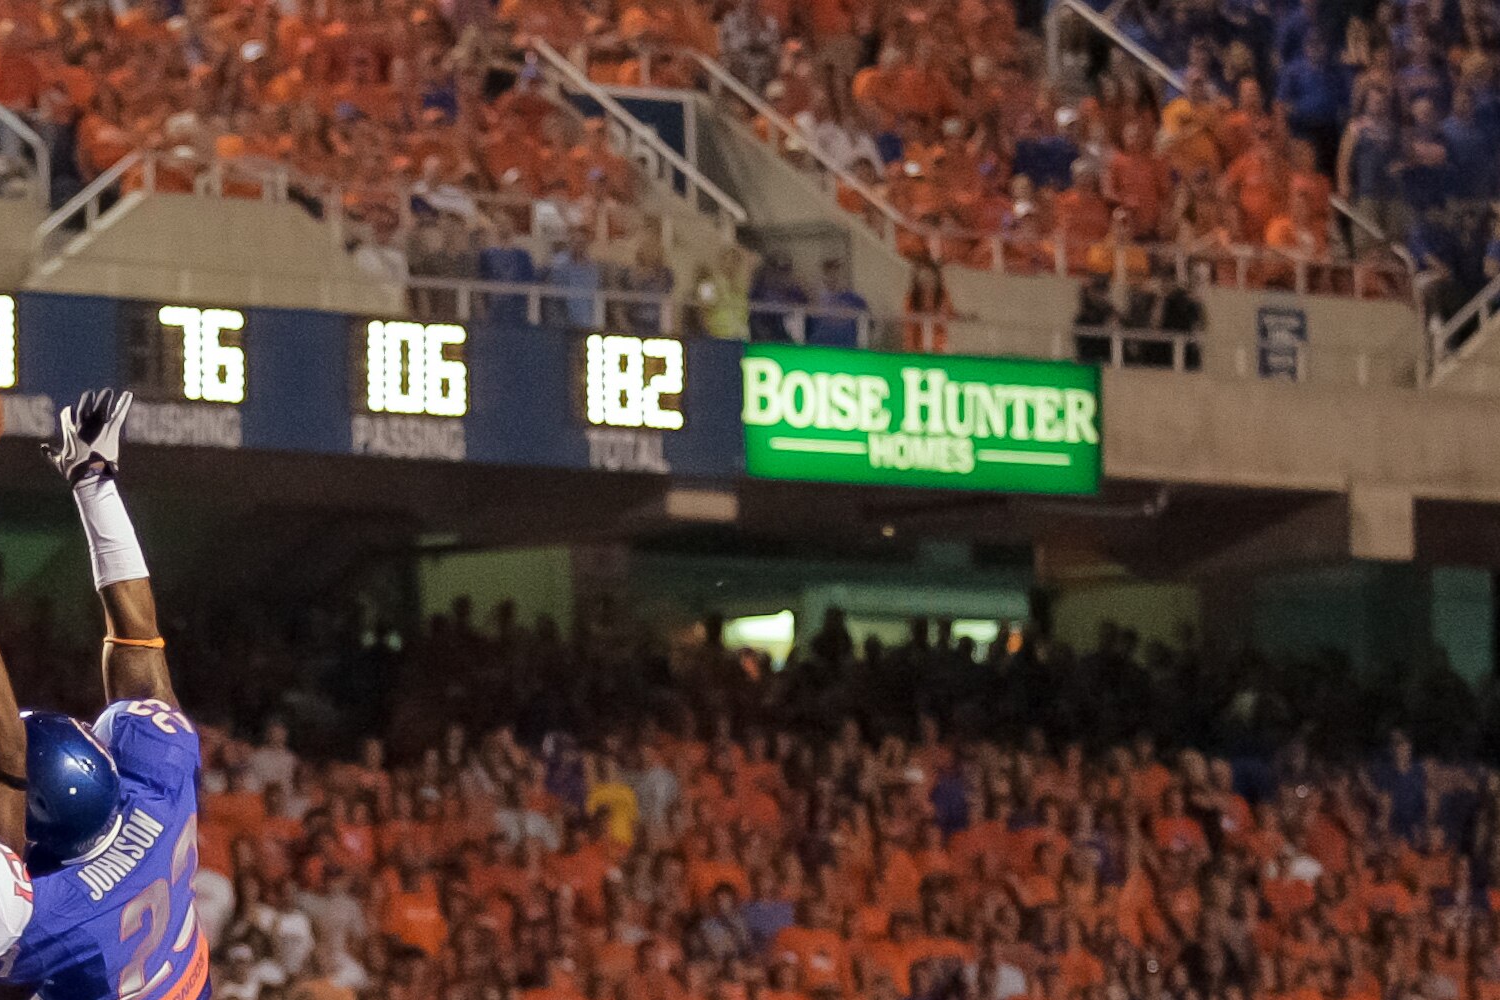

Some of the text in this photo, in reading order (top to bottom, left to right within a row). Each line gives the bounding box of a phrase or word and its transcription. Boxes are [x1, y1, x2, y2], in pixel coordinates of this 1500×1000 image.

[158, 305, 246, 404] 76
[367, 320, 468, 417] 106
[586, 334, 685, 430] 182
[77, 808, 164, 901] JOHNSON
